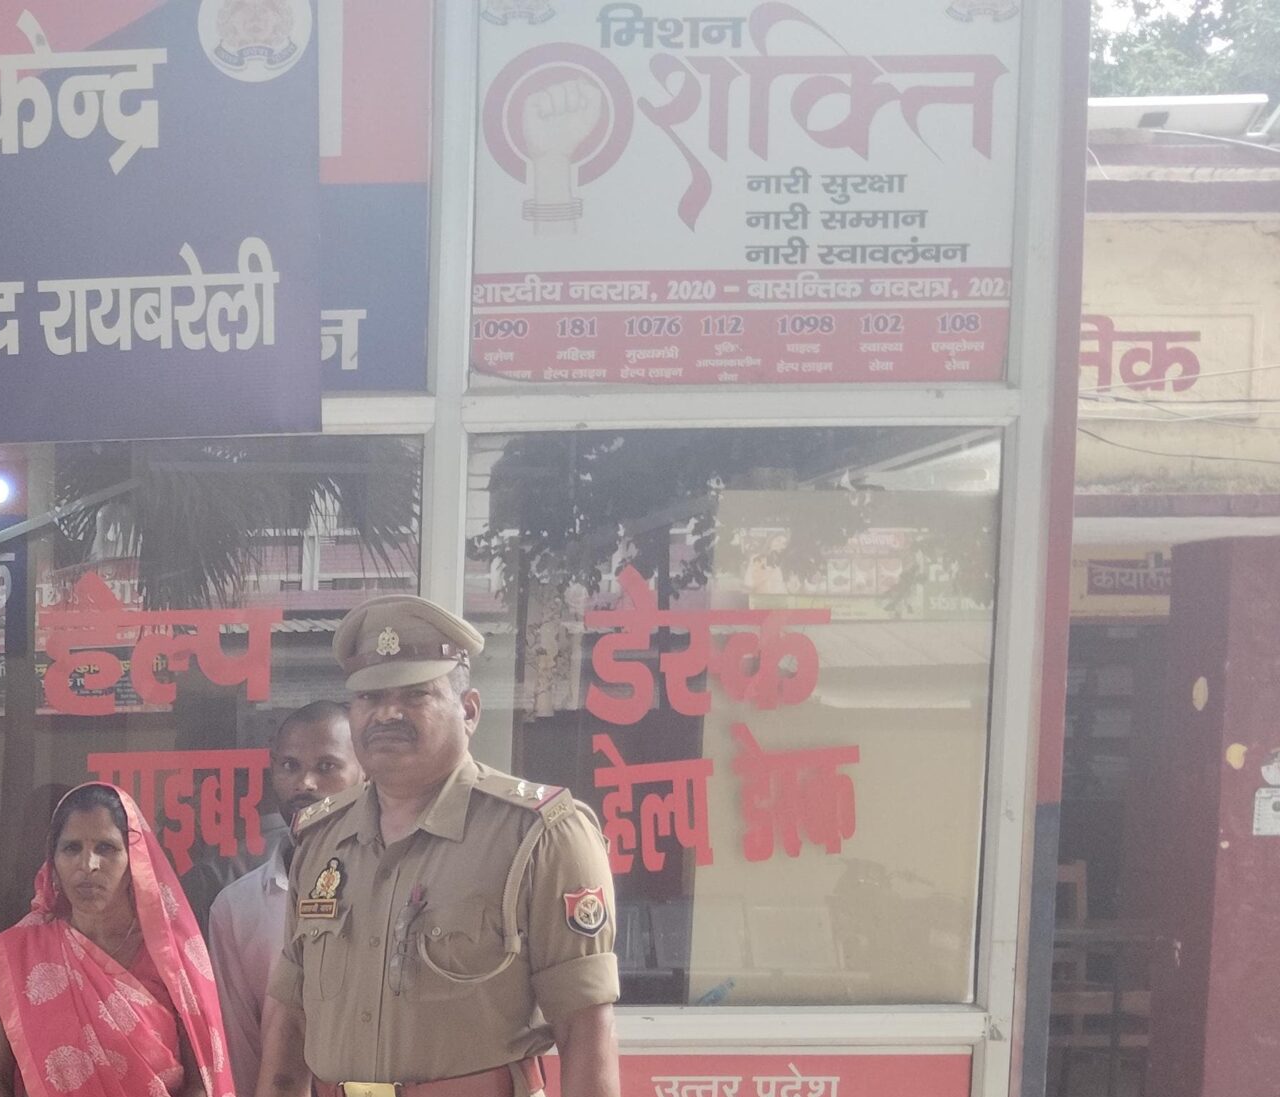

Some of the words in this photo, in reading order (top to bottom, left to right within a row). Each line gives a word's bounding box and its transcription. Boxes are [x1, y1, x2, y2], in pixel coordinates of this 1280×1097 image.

[597, 4, 745, 49] मिशन
[636, 0, 1010, 232] शक्ति
[746, 167, 810, 194] नारी
[821, 172, 907, 202] सुरक्षा
[745, 203, 809, 230] नारी
[820, 208, 928, 230] सम्मान
[745, 237, 808, 264] नारी
[818, 236, 970, 264] स्वावलंबन
[37, 237, 280, 356] रायबरेली
[667, 280, 717, 301] 2020
[473, 319, 528, 340] 1090
[557, 317, 599, 338] 181
[625, 316, 683, 337] 1076
[701, 315, 745, 336] 112
[777, 314, 835, 335] 1098
[860, 314, 904, 335] 102
[938, 312, 981, 332] 108
[584, 564, 831, 726] डेस्क
[593, 733, 714, 875] हेल्प
